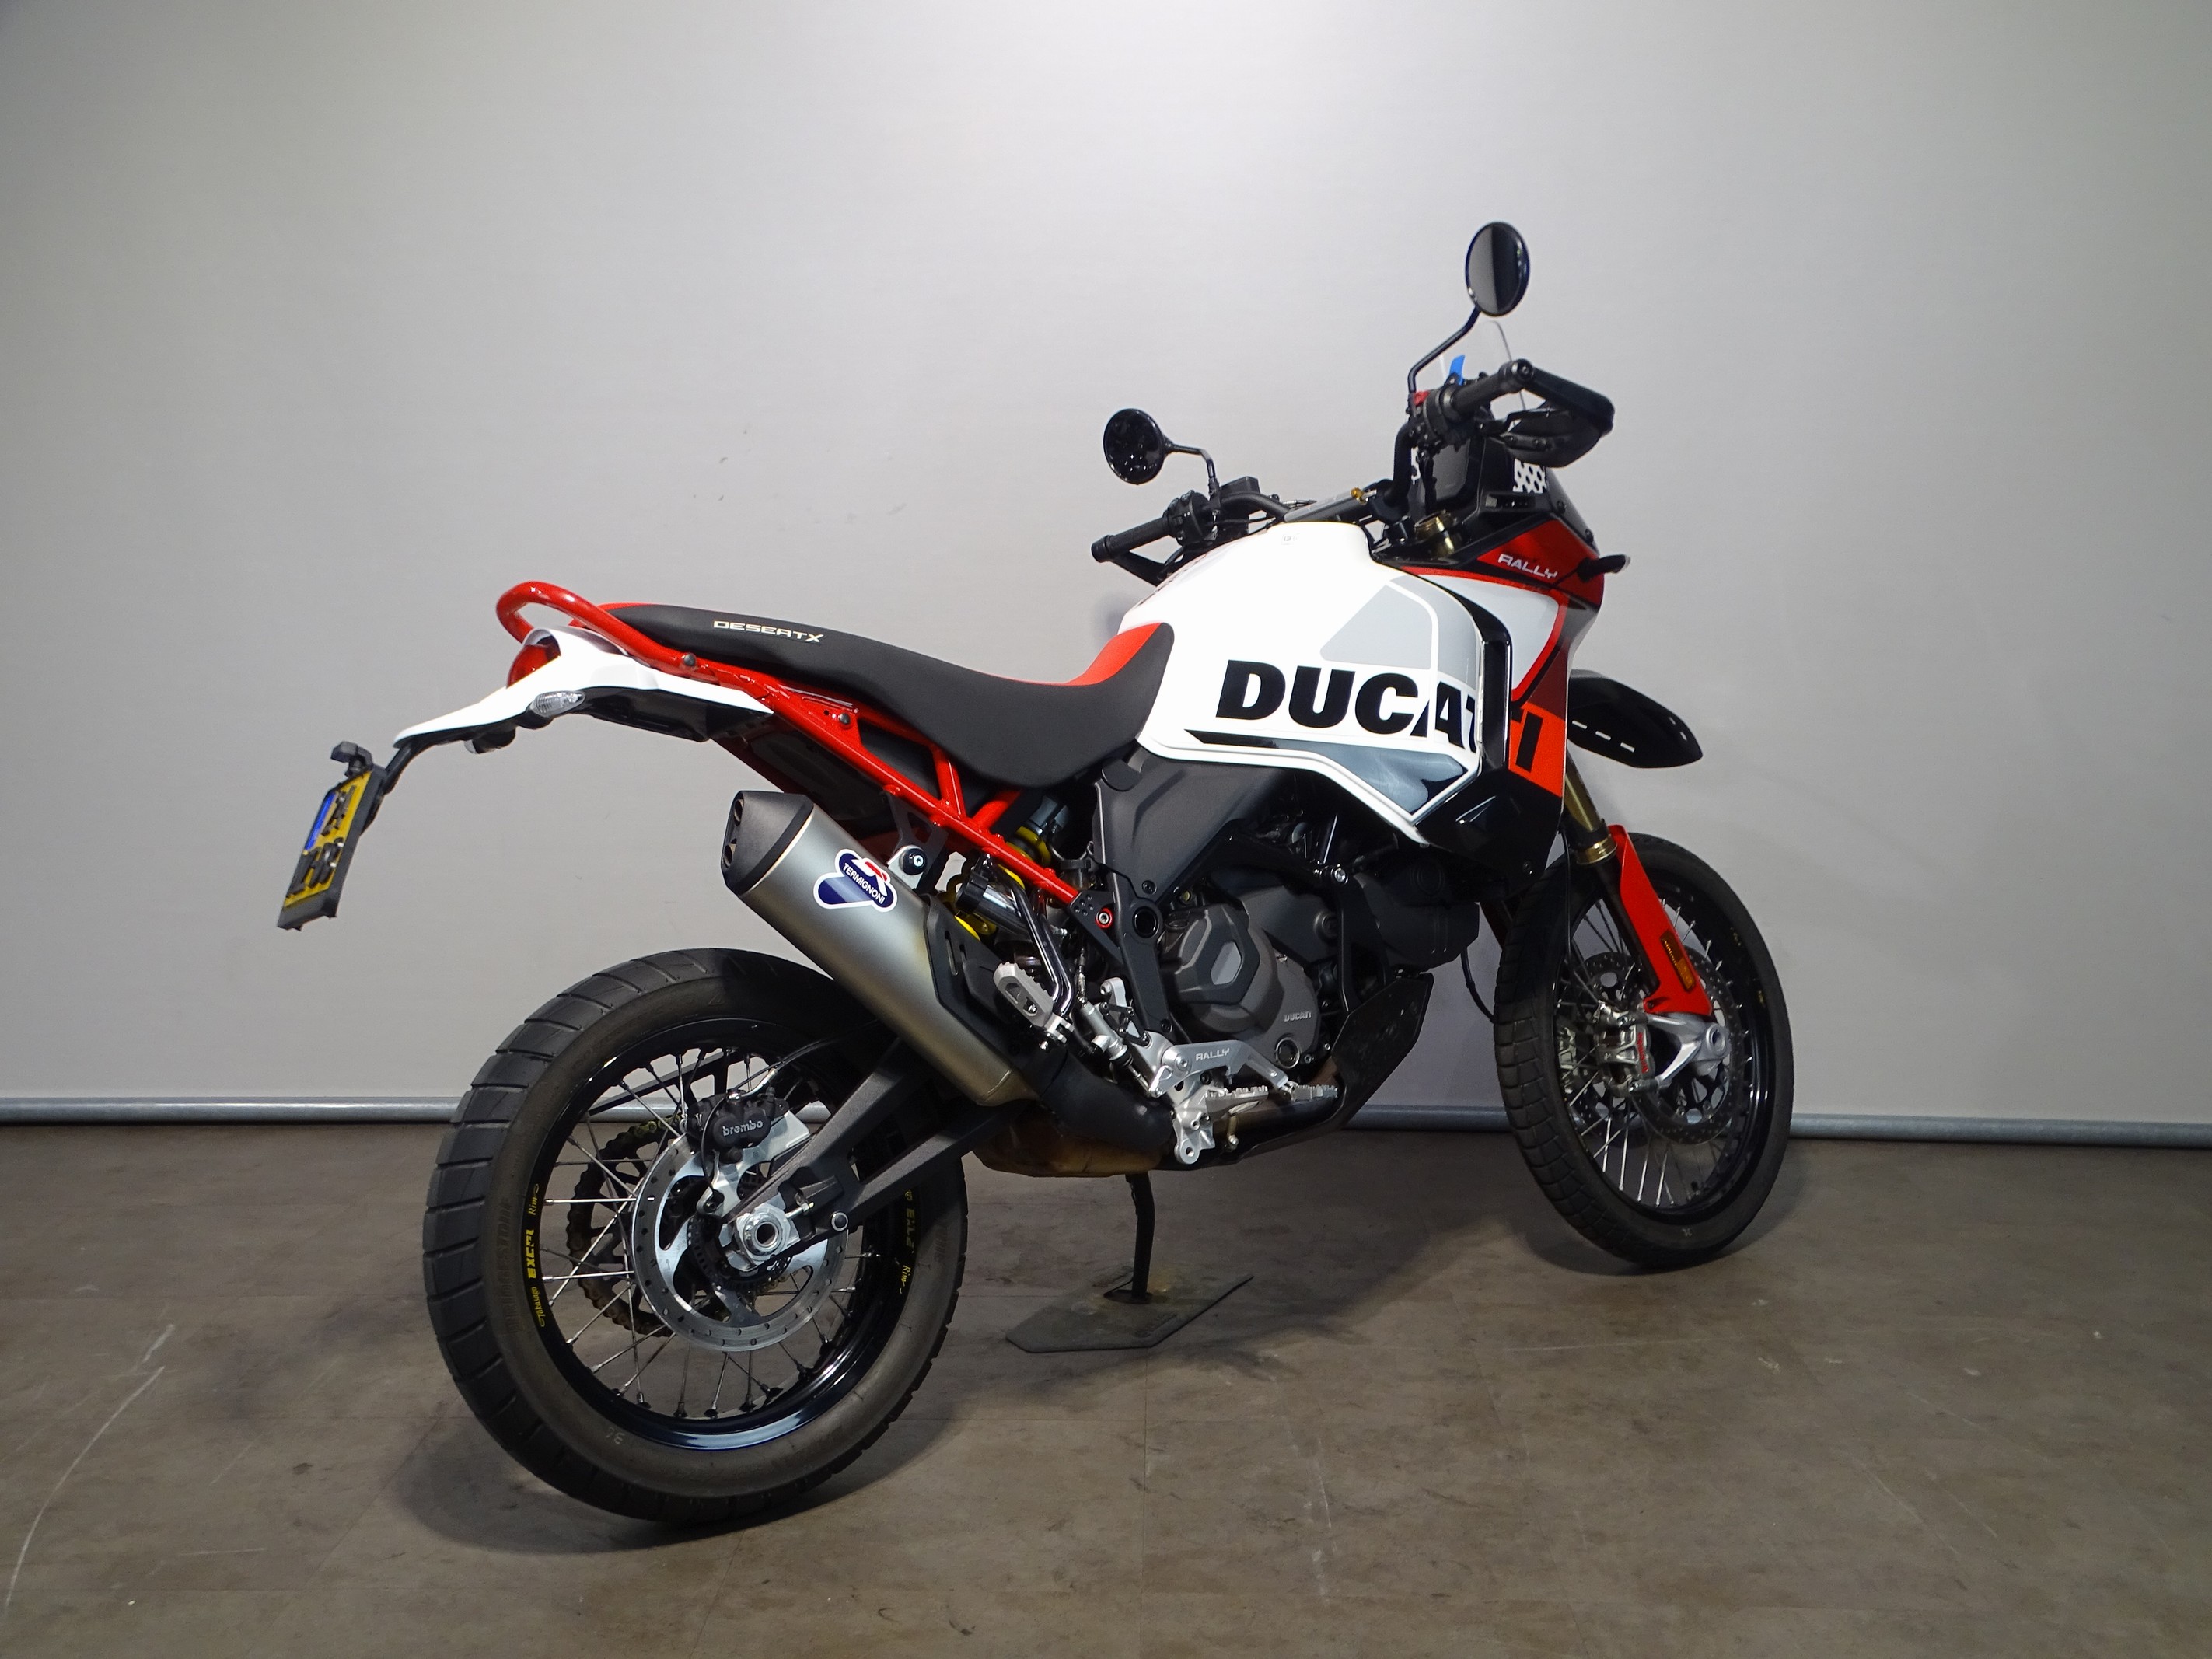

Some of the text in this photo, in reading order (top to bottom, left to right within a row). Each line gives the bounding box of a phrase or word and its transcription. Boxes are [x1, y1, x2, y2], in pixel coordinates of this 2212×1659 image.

[1497, 554, 1558, 579] RALLY
[713, 620, 824, 643] DESERTX
[842, 862, 886, 905] TERMIGNONI
[1284, 1011, 1312, 1022] DUCATI
[1195, 1048, 1230, 1061] RALLY
[722, 1120, 763, 1137] brembo
